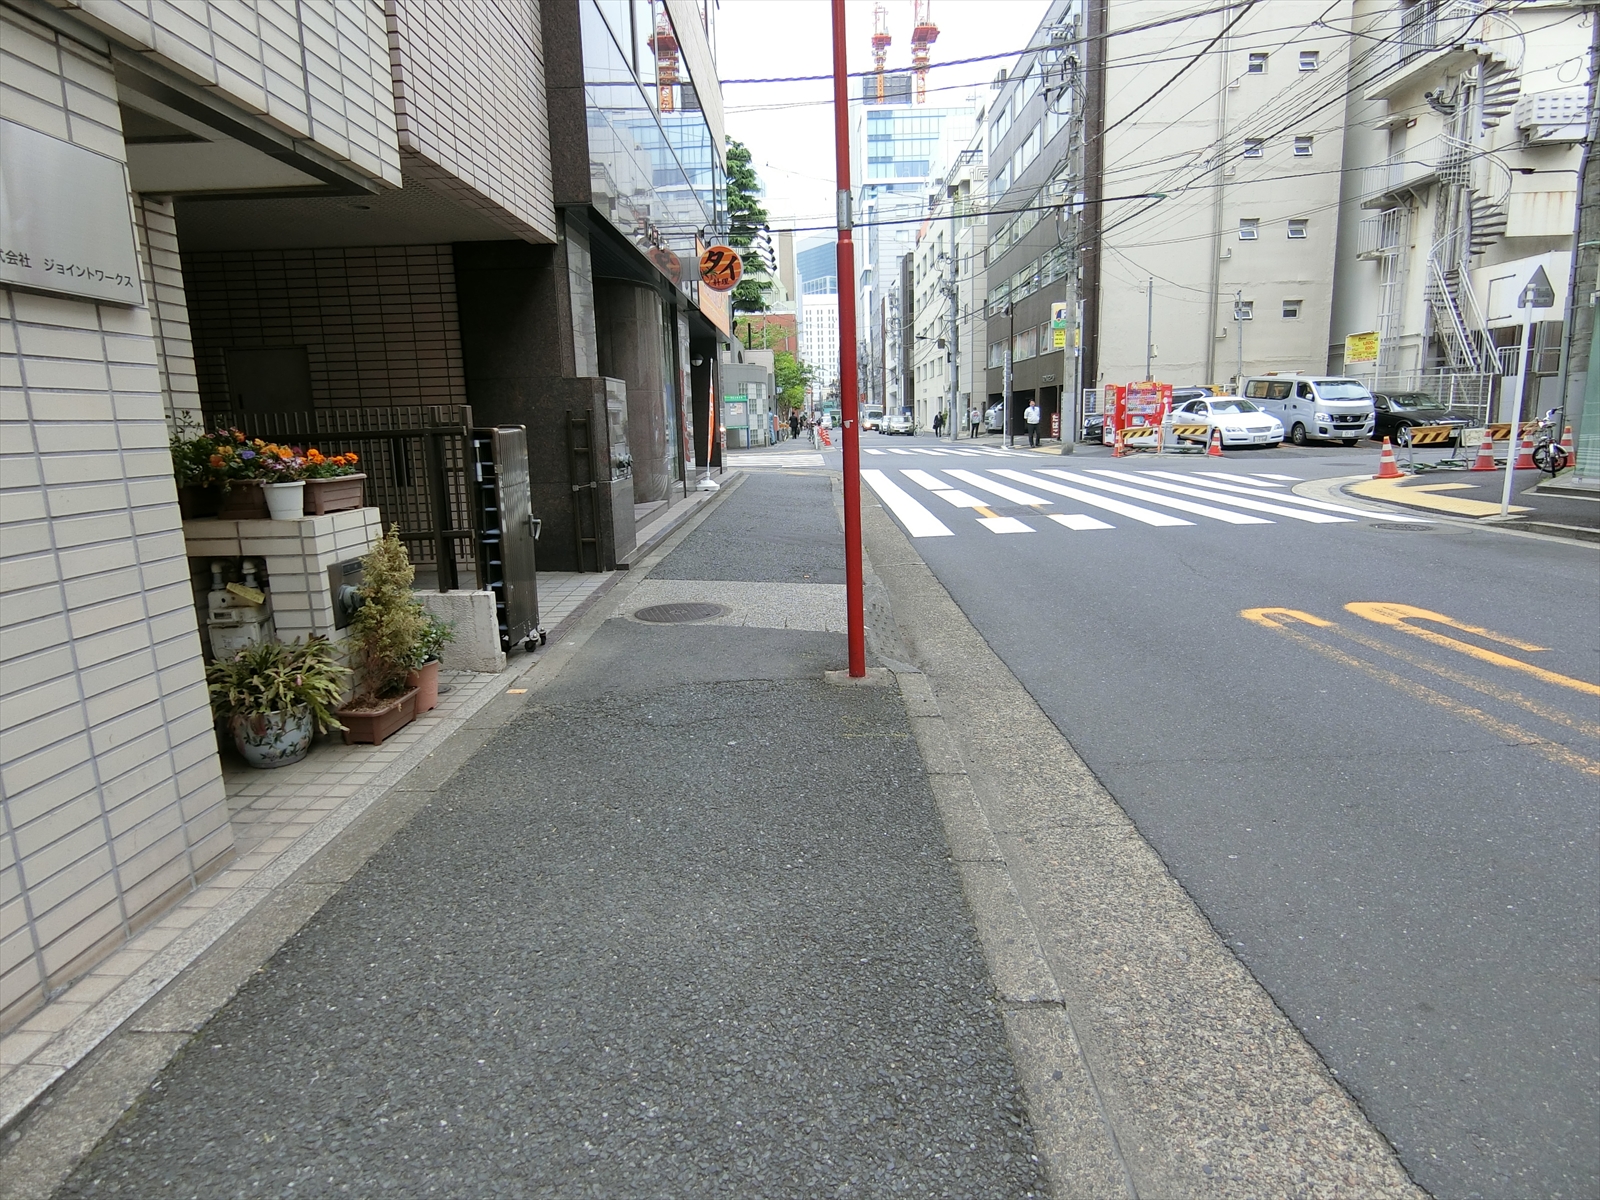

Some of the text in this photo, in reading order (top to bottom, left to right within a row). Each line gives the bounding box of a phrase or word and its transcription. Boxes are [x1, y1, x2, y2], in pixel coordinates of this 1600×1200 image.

[44, 258, 134, 288] ジョイントワークス
[704, 250, 738, 281] タイ
